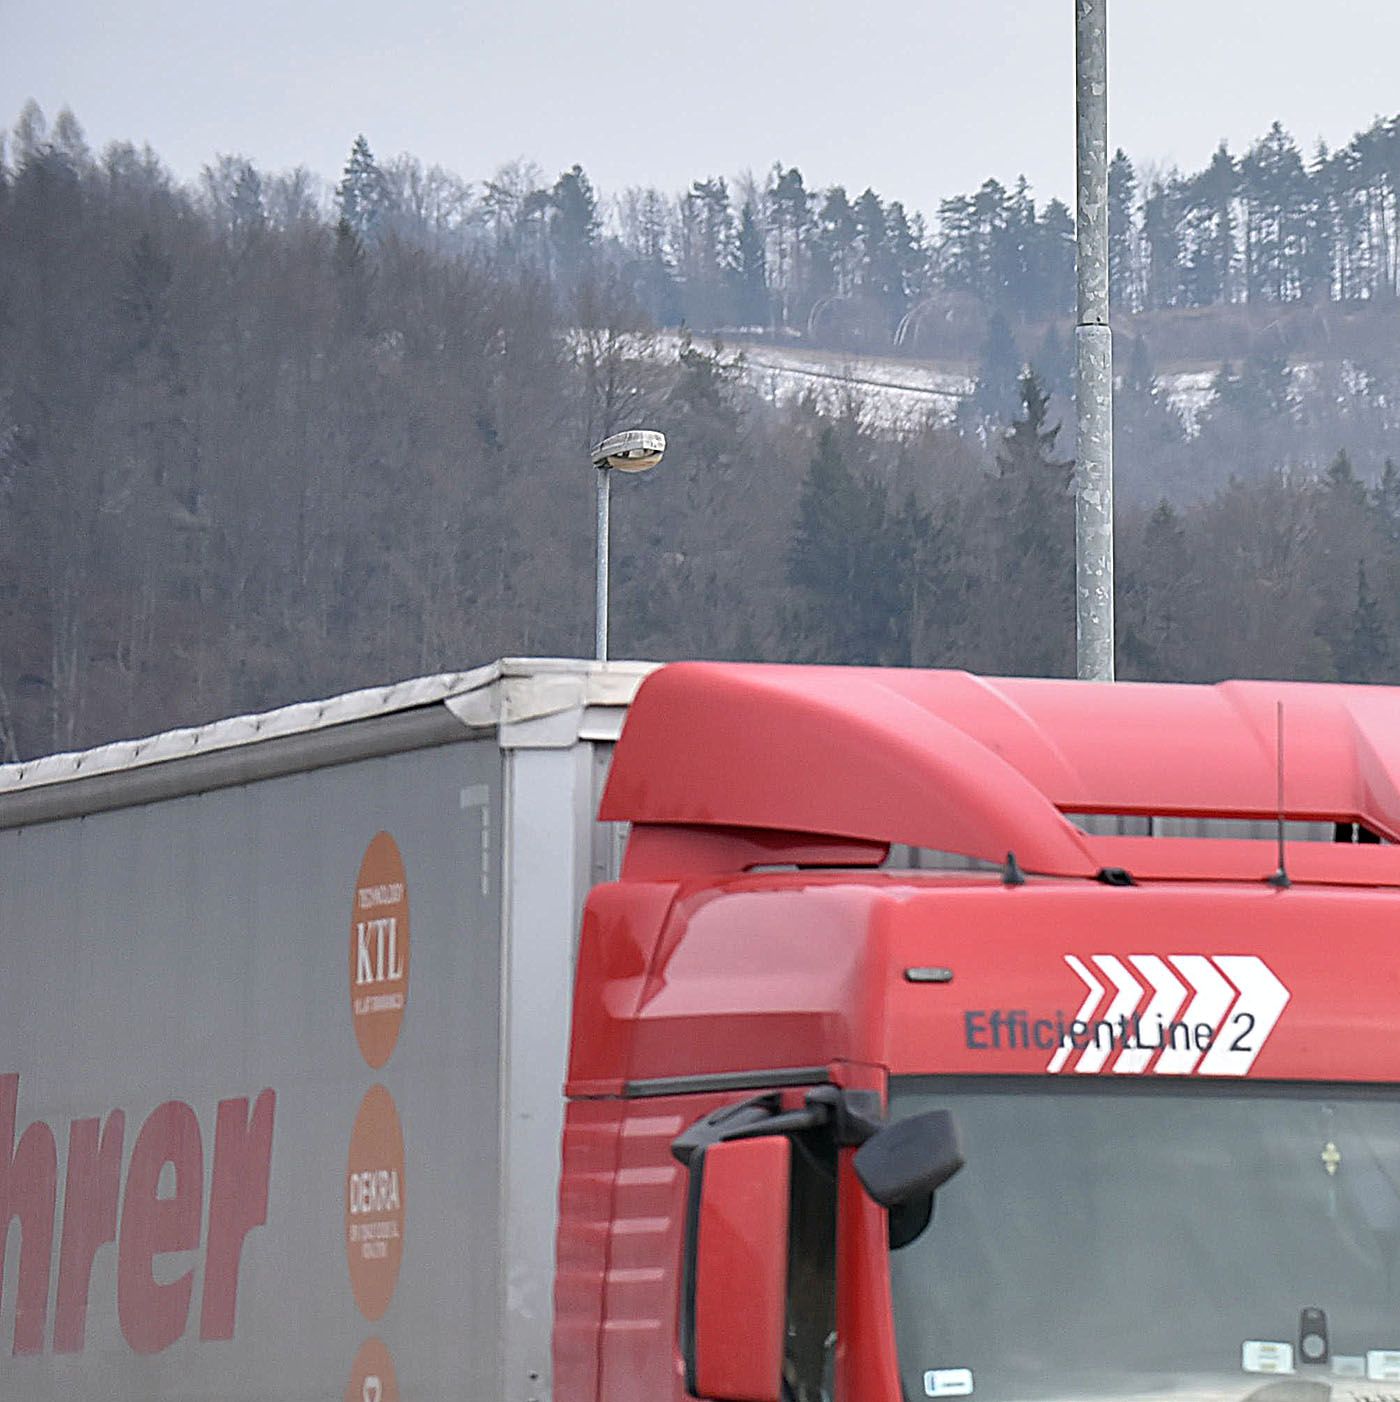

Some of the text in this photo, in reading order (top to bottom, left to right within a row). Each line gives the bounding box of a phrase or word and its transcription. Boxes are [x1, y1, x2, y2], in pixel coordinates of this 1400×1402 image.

[356, 917, 403, 984] KTL
[964, 1010, 1256, 1052] EfficientLine 2
[0, 1072, 277, 1357] hrer
[350, 1169, 400, 1213] DEKRA
